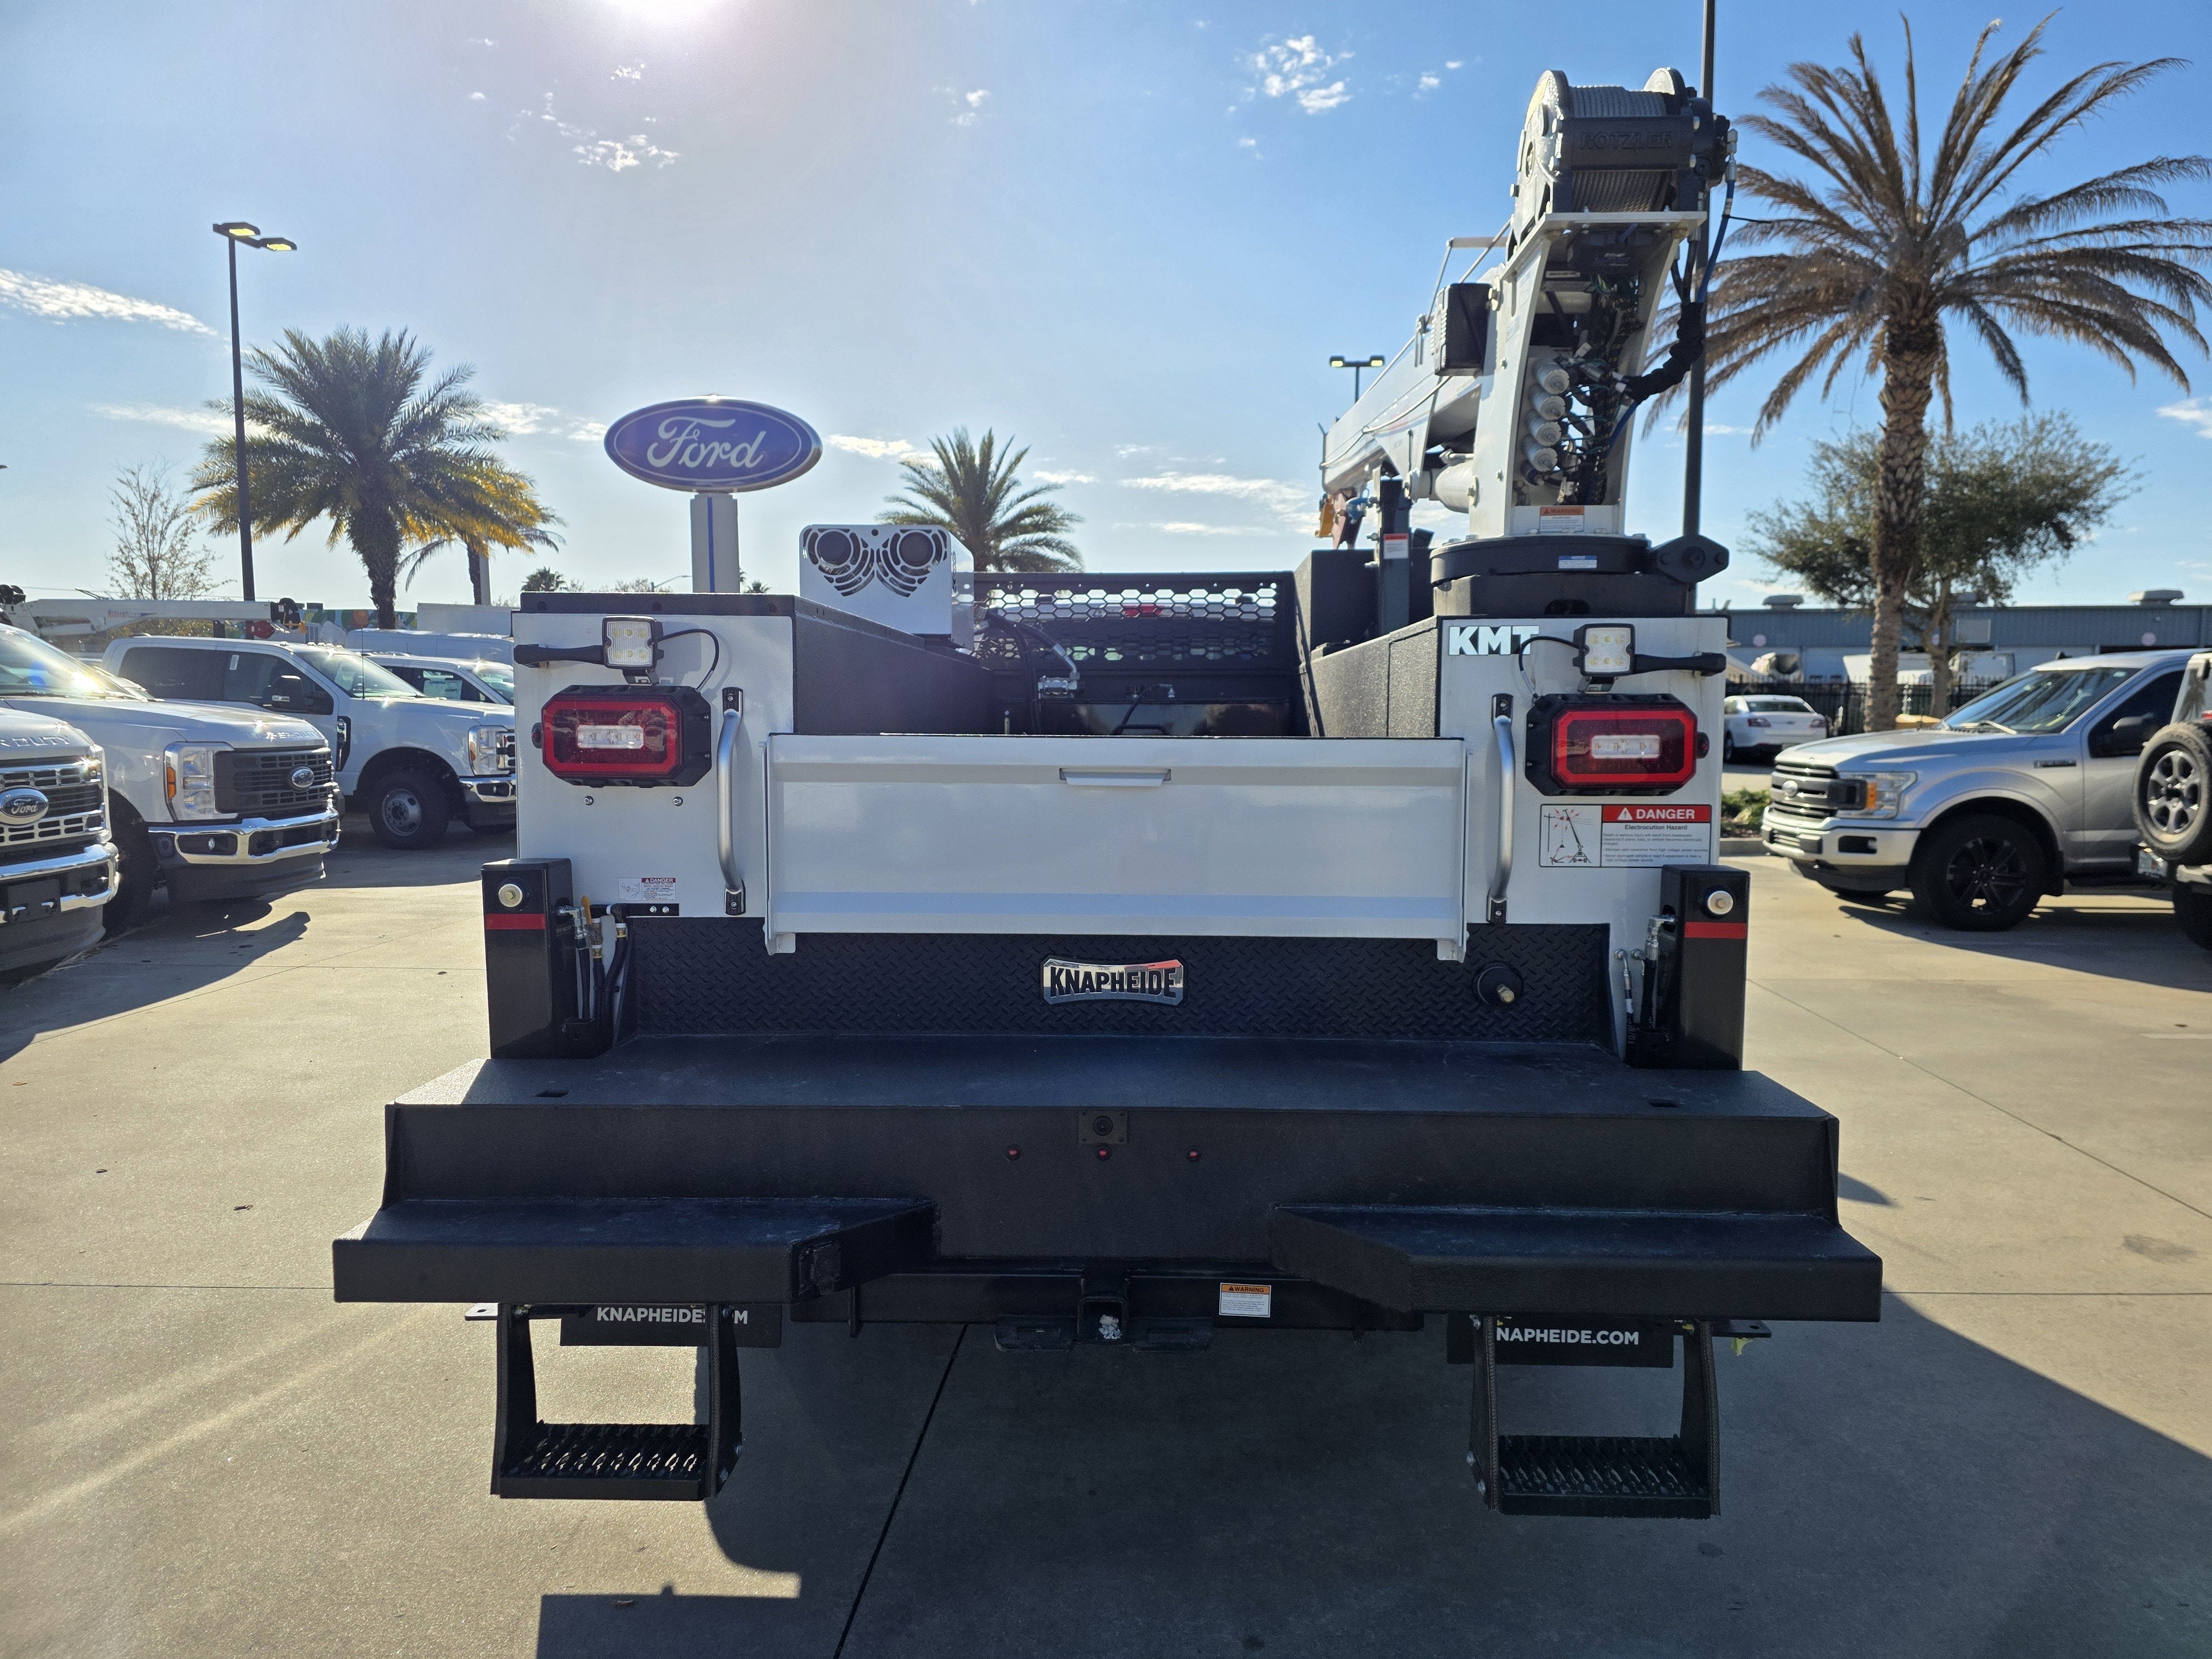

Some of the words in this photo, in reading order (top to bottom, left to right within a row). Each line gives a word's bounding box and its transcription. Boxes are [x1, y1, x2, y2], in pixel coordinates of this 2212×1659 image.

[646, 416, 766, 468] Ford
[1449, 625, 1540, 656] KMT
[11, 799, 38, 815] Ford
[1636, 808, 1695, 820] DANGER
[1050, 966, 1176, 998] KNAPHEIDE
[597, 1307, 748, 1324] KNAPHEIDE.M
[1496, 1327, 1639, 1345] NAPHEIDE.COM
